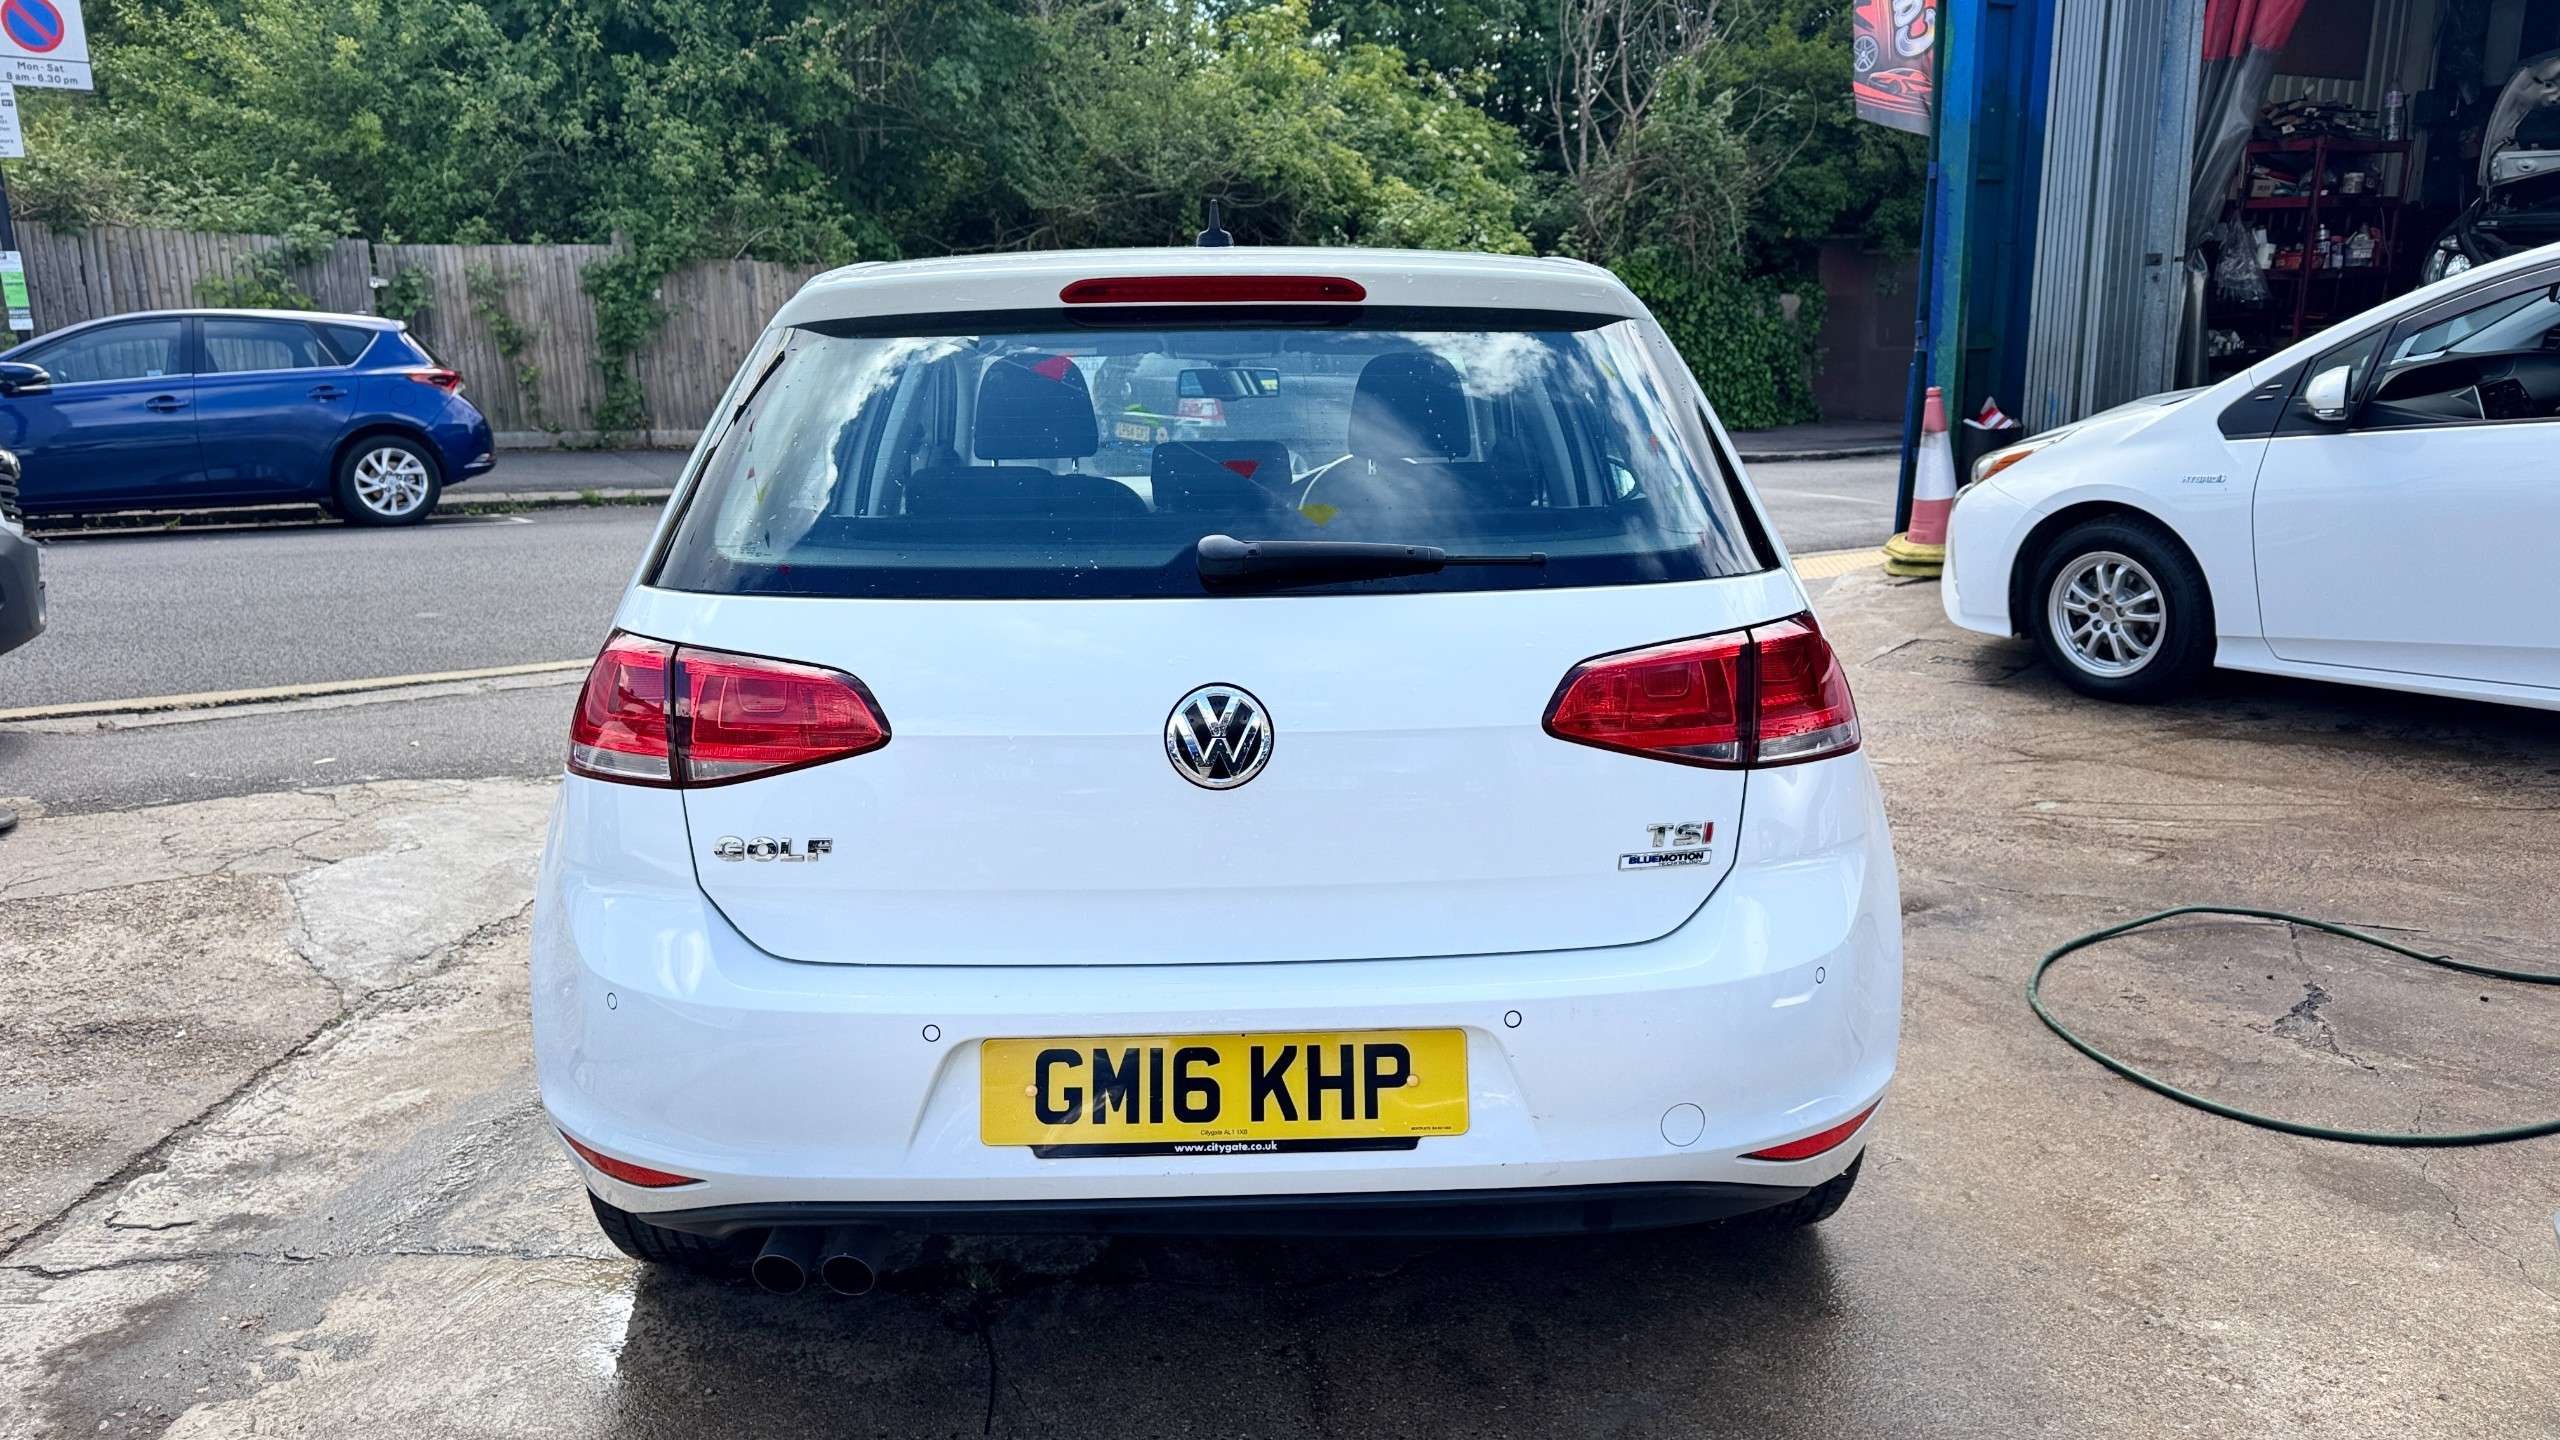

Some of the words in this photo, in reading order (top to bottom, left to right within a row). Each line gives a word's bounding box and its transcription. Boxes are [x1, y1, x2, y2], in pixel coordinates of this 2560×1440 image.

[17, 61, 39, 71] Mon
[46, 63, 64, 73] Sat
[63, 77, 78, 85] pm
[1647, 821, 1714, 848] TSI
[713, 834, 833, 862] GOLF
[1628, 851, 1704, 865] BLUEMOTION
[1034, 1047, 1221, 1125] GM16
[1249, 1043, 1412, 1122] KHP
[1174, 1140, 1278, 1154] www.citygate.co.uk
